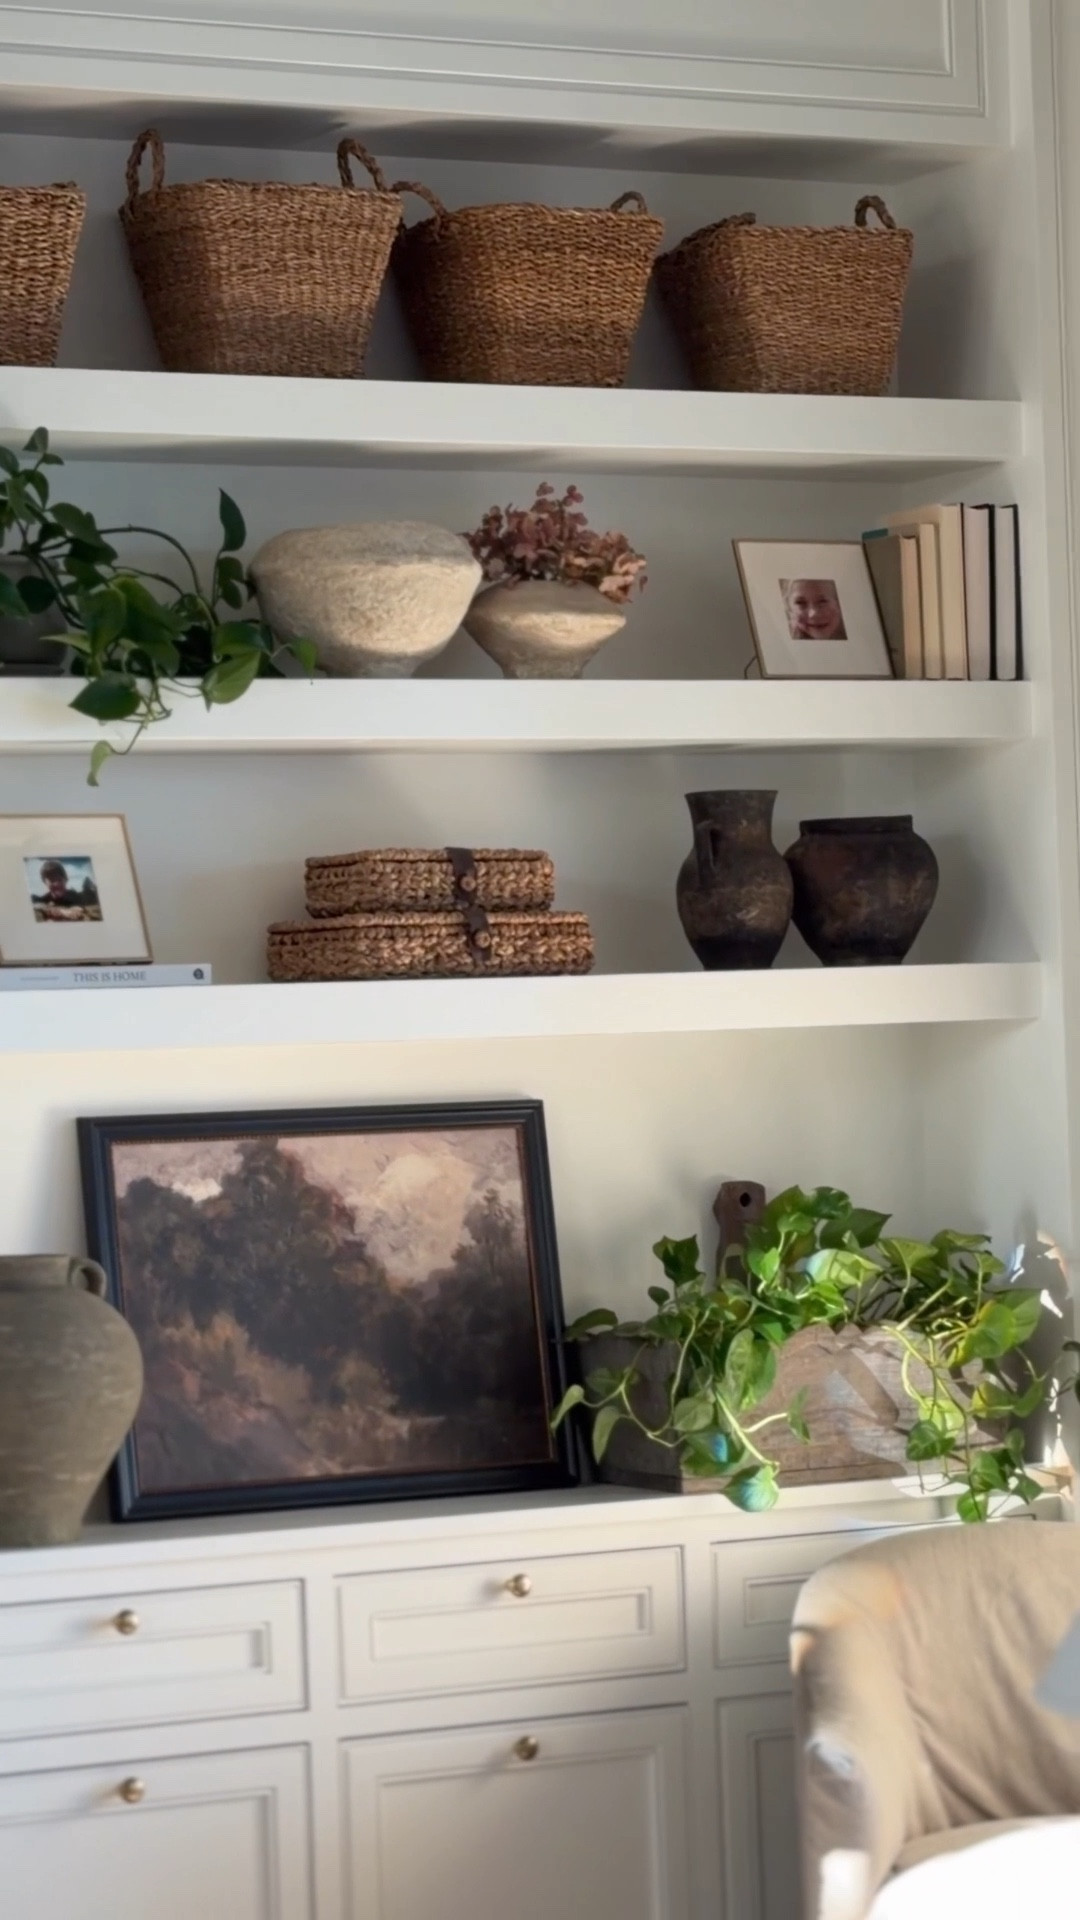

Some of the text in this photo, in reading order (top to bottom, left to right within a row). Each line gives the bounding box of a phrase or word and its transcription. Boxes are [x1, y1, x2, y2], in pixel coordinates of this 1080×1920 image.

[73, 971, 146, 982] THIS IS HOME
